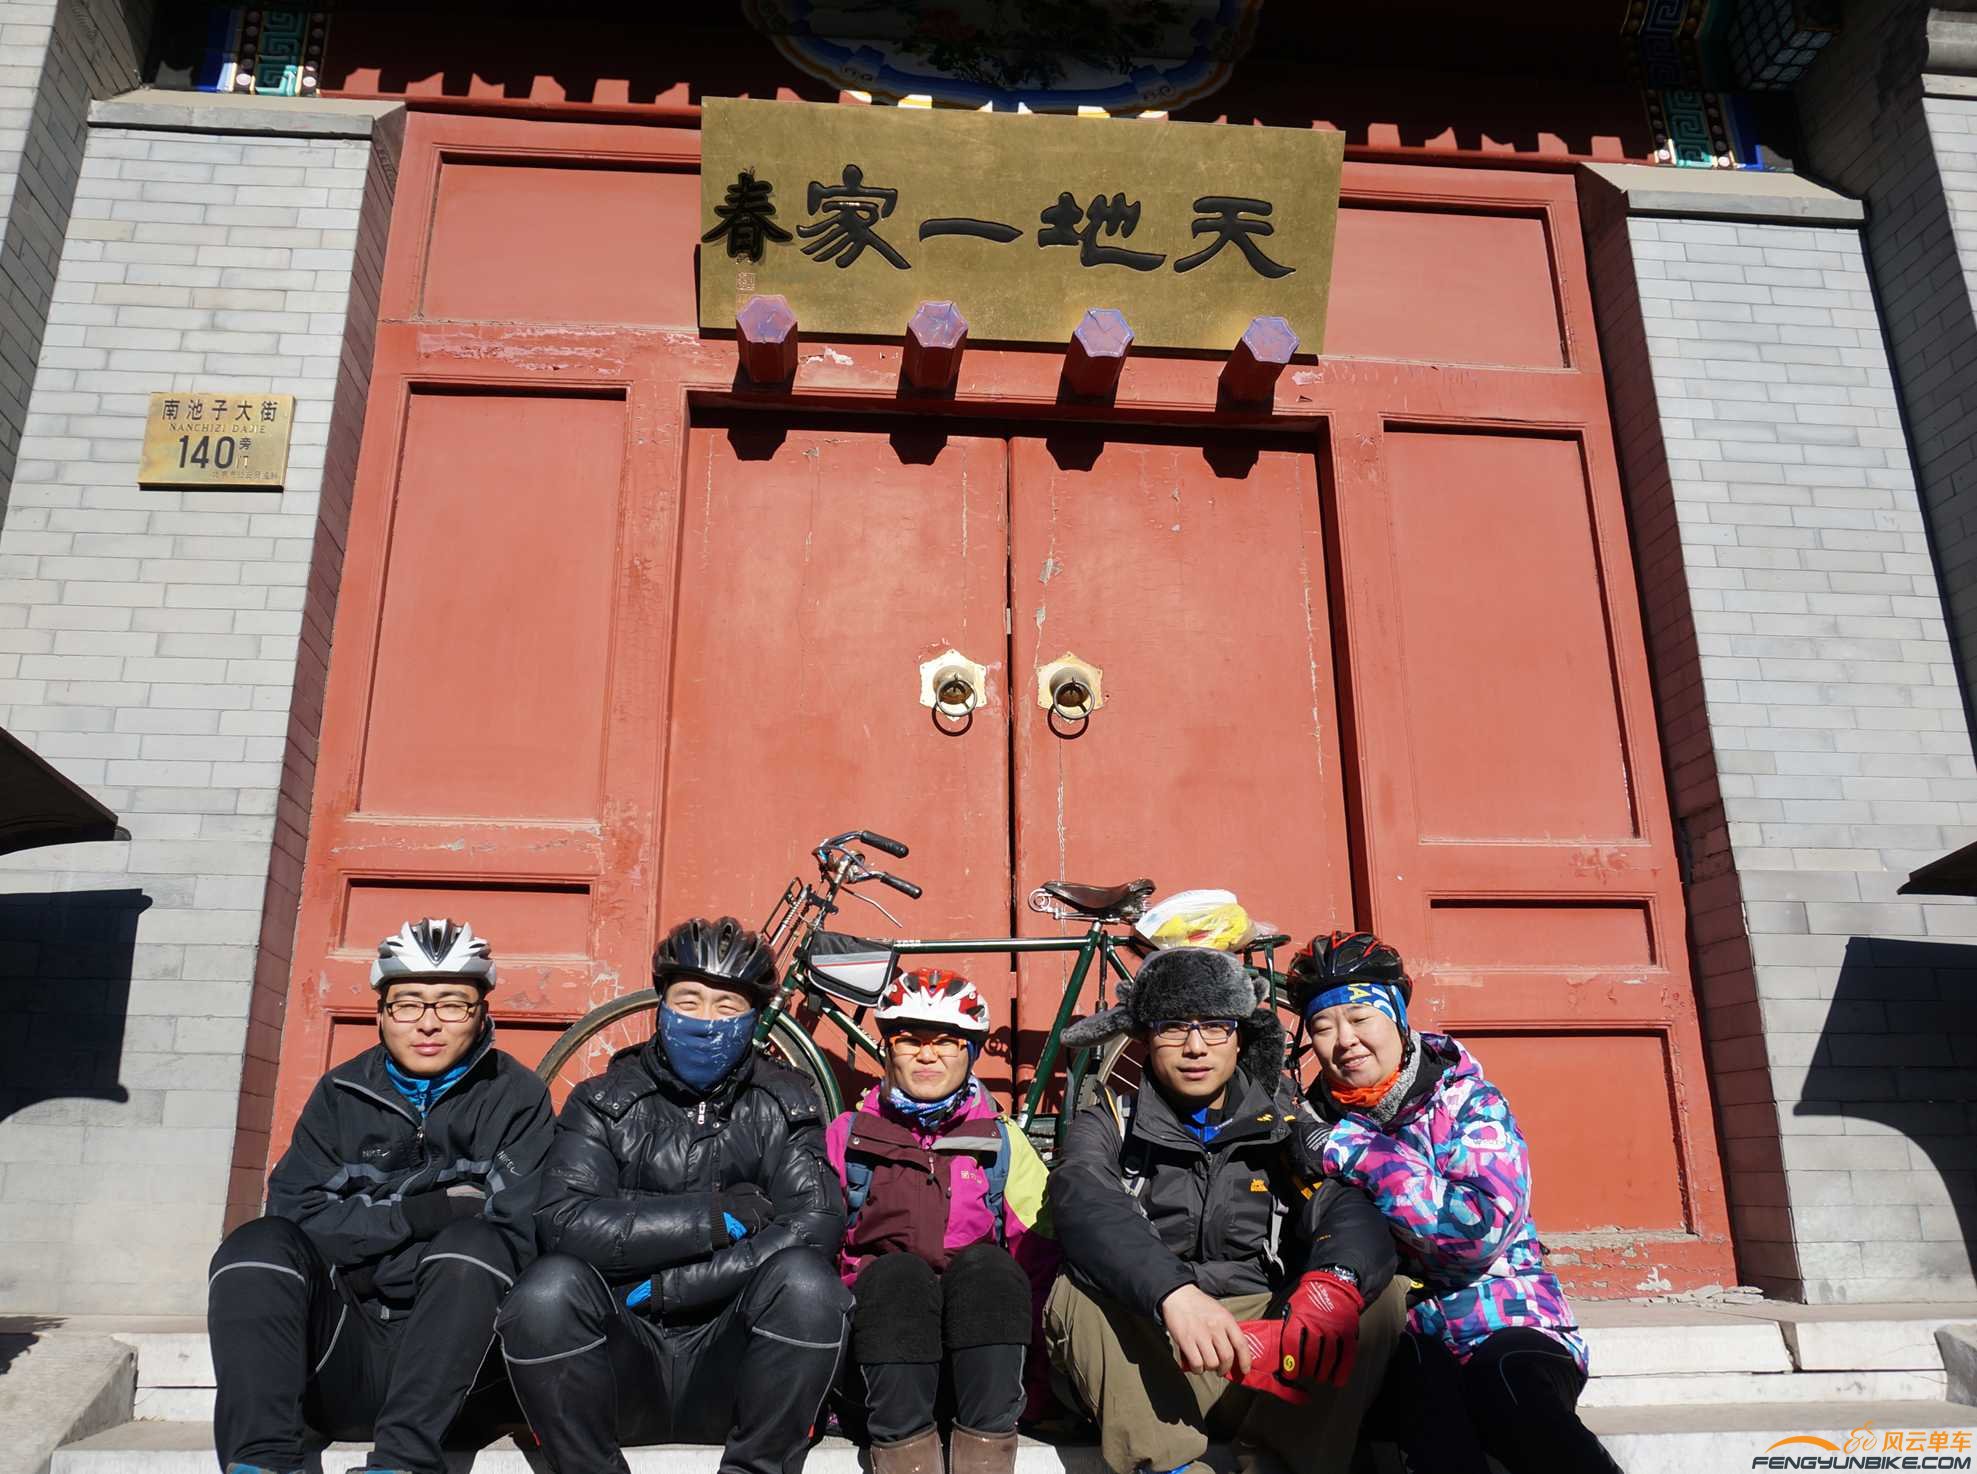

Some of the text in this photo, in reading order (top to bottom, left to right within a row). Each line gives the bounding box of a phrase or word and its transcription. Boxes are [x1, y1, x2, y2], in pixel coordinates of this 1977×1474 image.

[162, 398, 279, 423] 南池子大街
[168, 423, 267, 434] NANCHIZI DAJIE
[178, 434, 236, 470] 140
